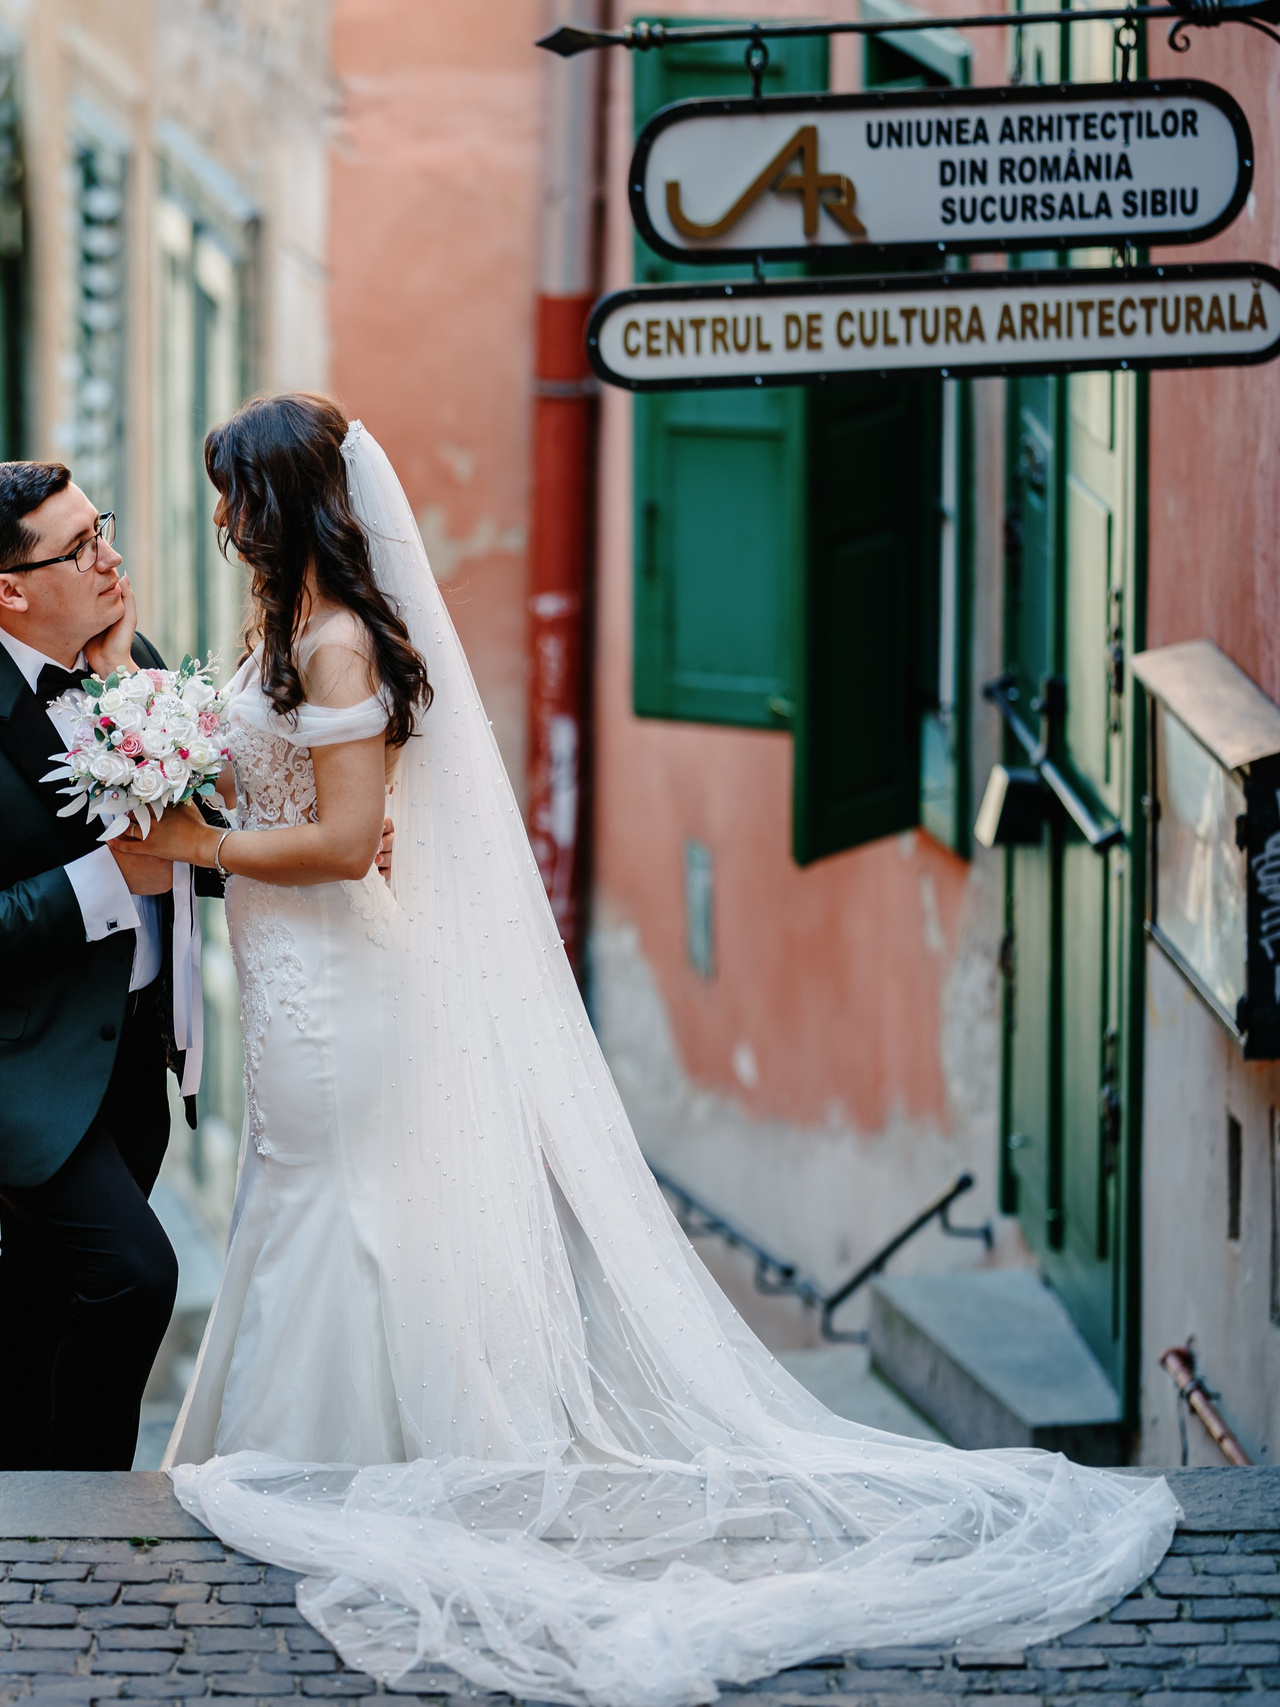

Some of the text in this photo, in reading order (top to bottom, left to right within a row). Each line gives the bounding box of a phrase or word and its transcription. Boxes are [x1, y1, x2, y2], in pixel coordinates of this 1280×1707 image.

[866, 117, 990, 150] UNIUNEA
[939, 147, 1133, 187] DIN ROMÂNIA
[940, 186, 1199, 225] SUCURSALA SIBIU
[623, 278, 1268, 357] CENTRUL DE CULTURA ARHITECTURALĂ
